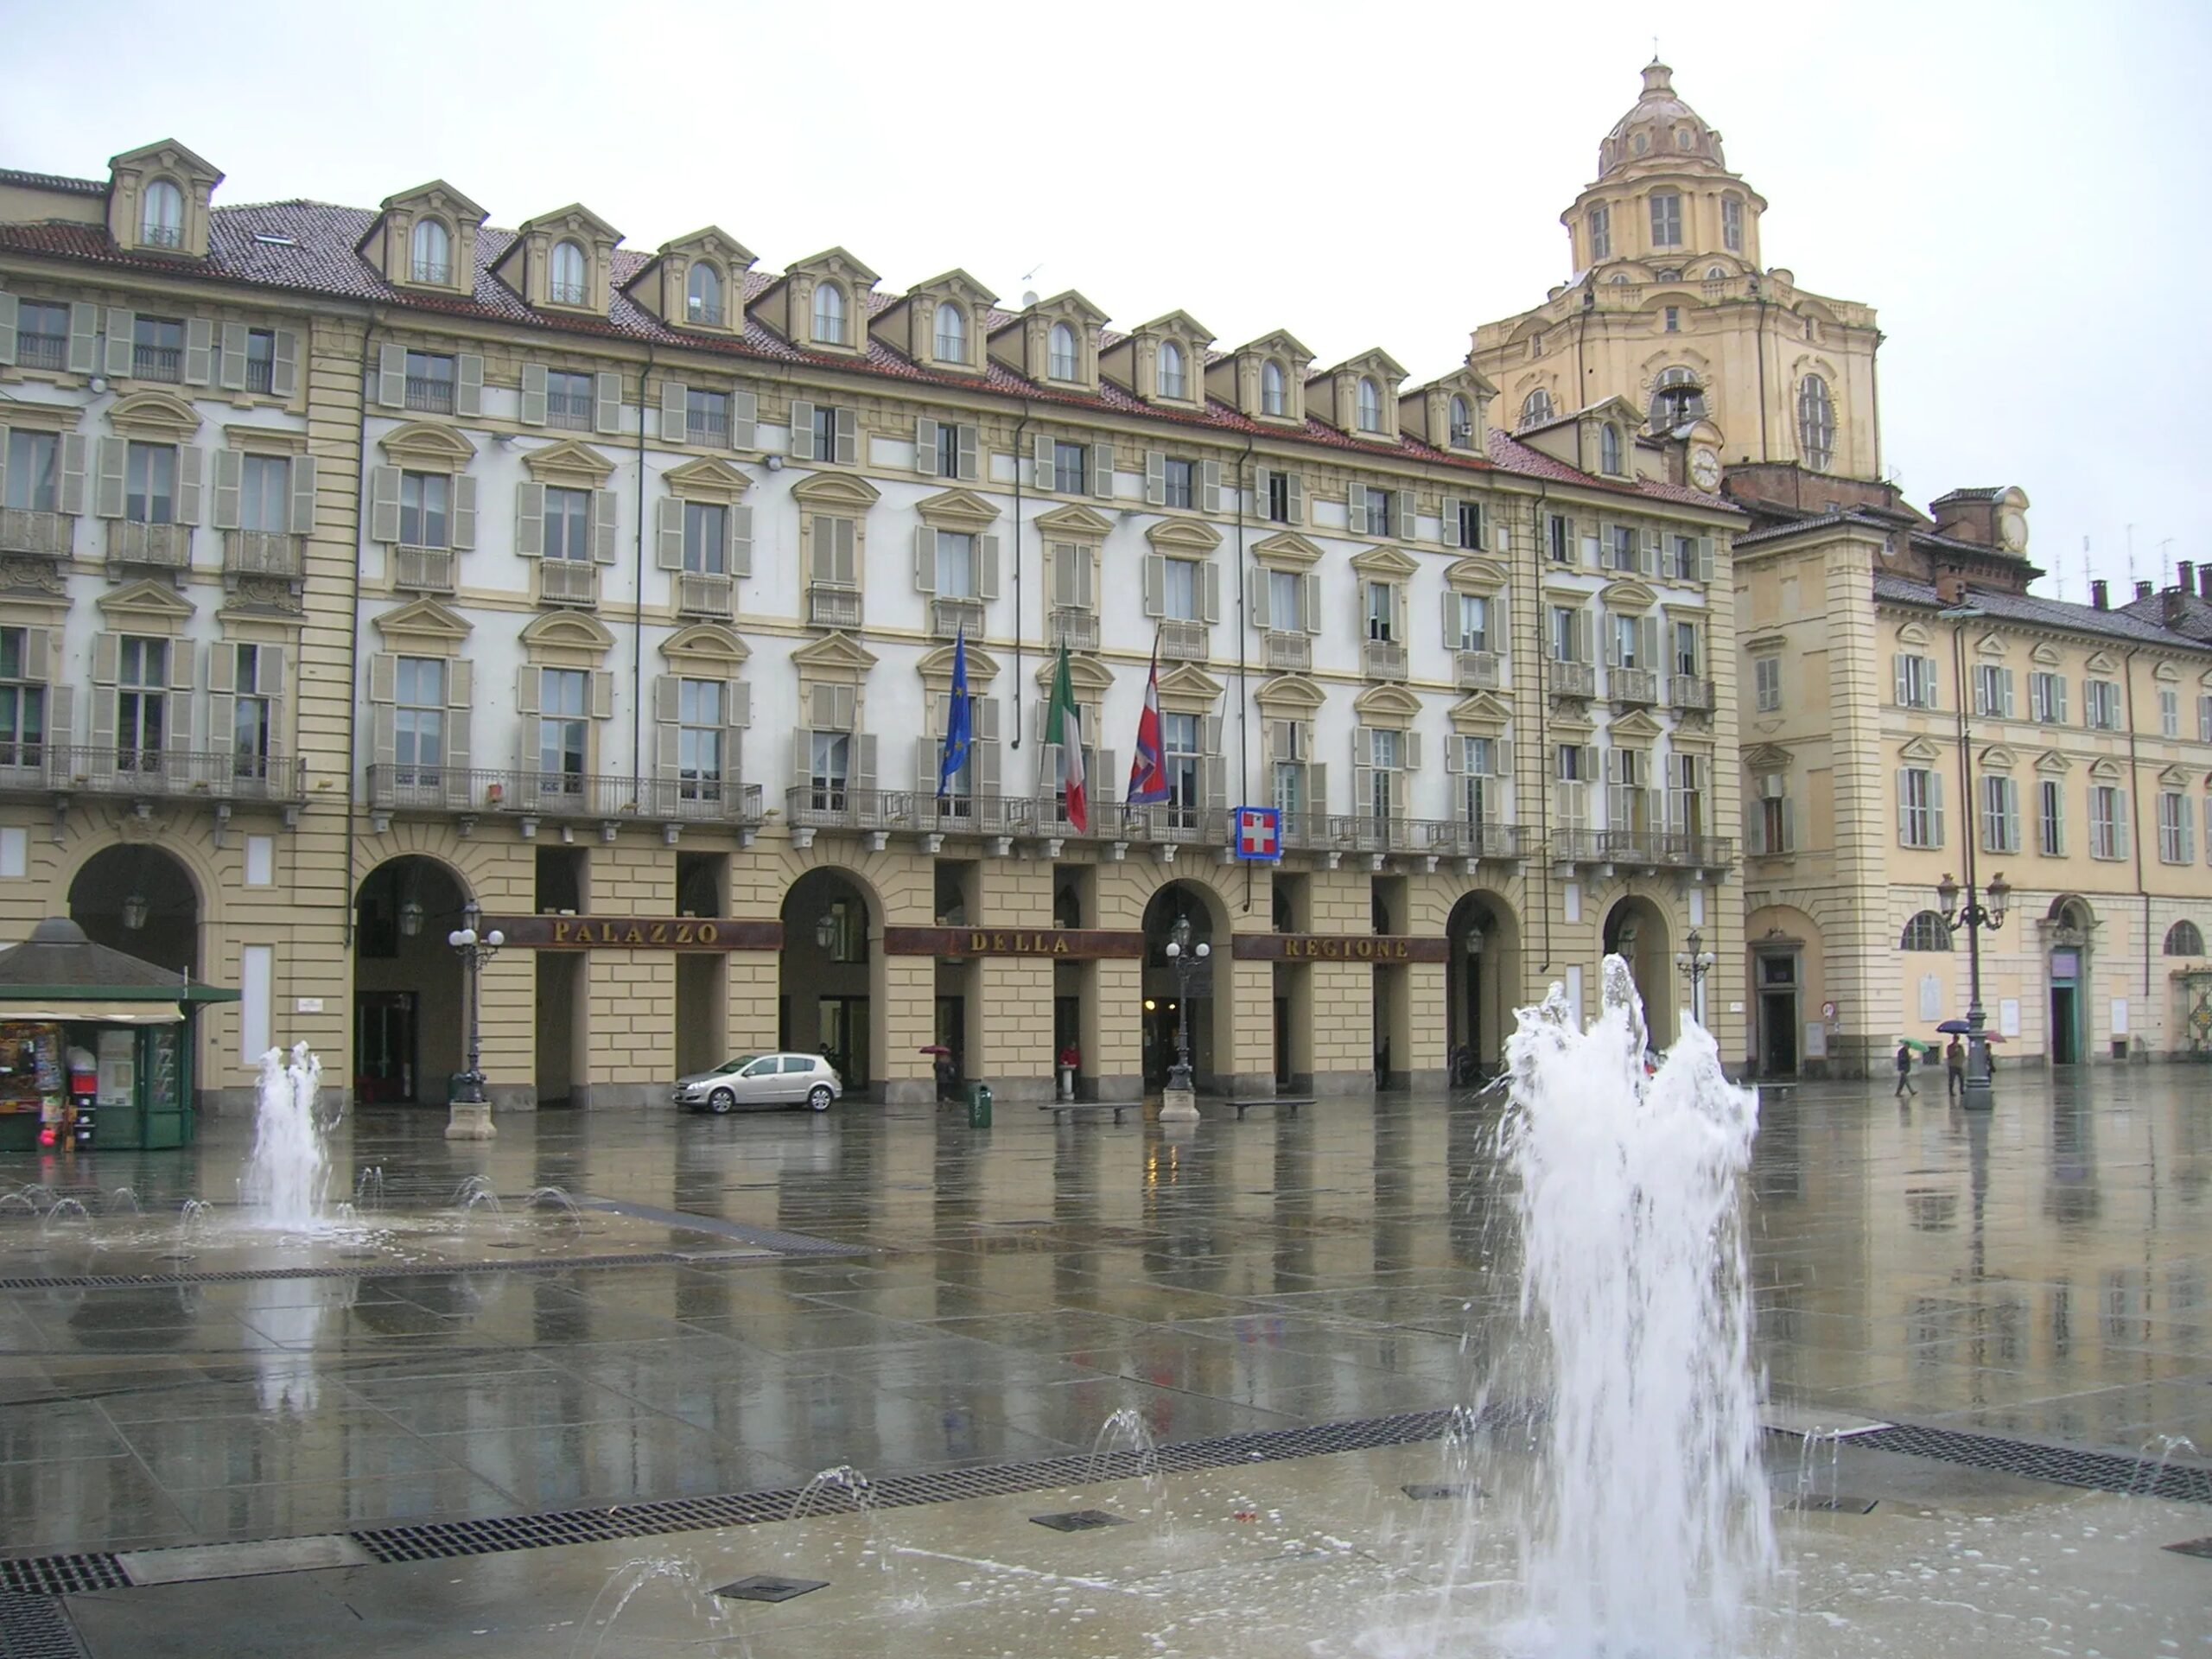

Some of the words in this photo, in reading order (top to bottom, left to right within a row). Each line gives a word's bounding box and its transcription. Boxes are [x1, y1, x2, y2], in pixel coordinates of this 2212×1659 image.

[554, 920, 718, 944] PALAZZO
[969, 933, 1069, 952] DELLA
[1285, 938, 1408, 957] REGIONE
